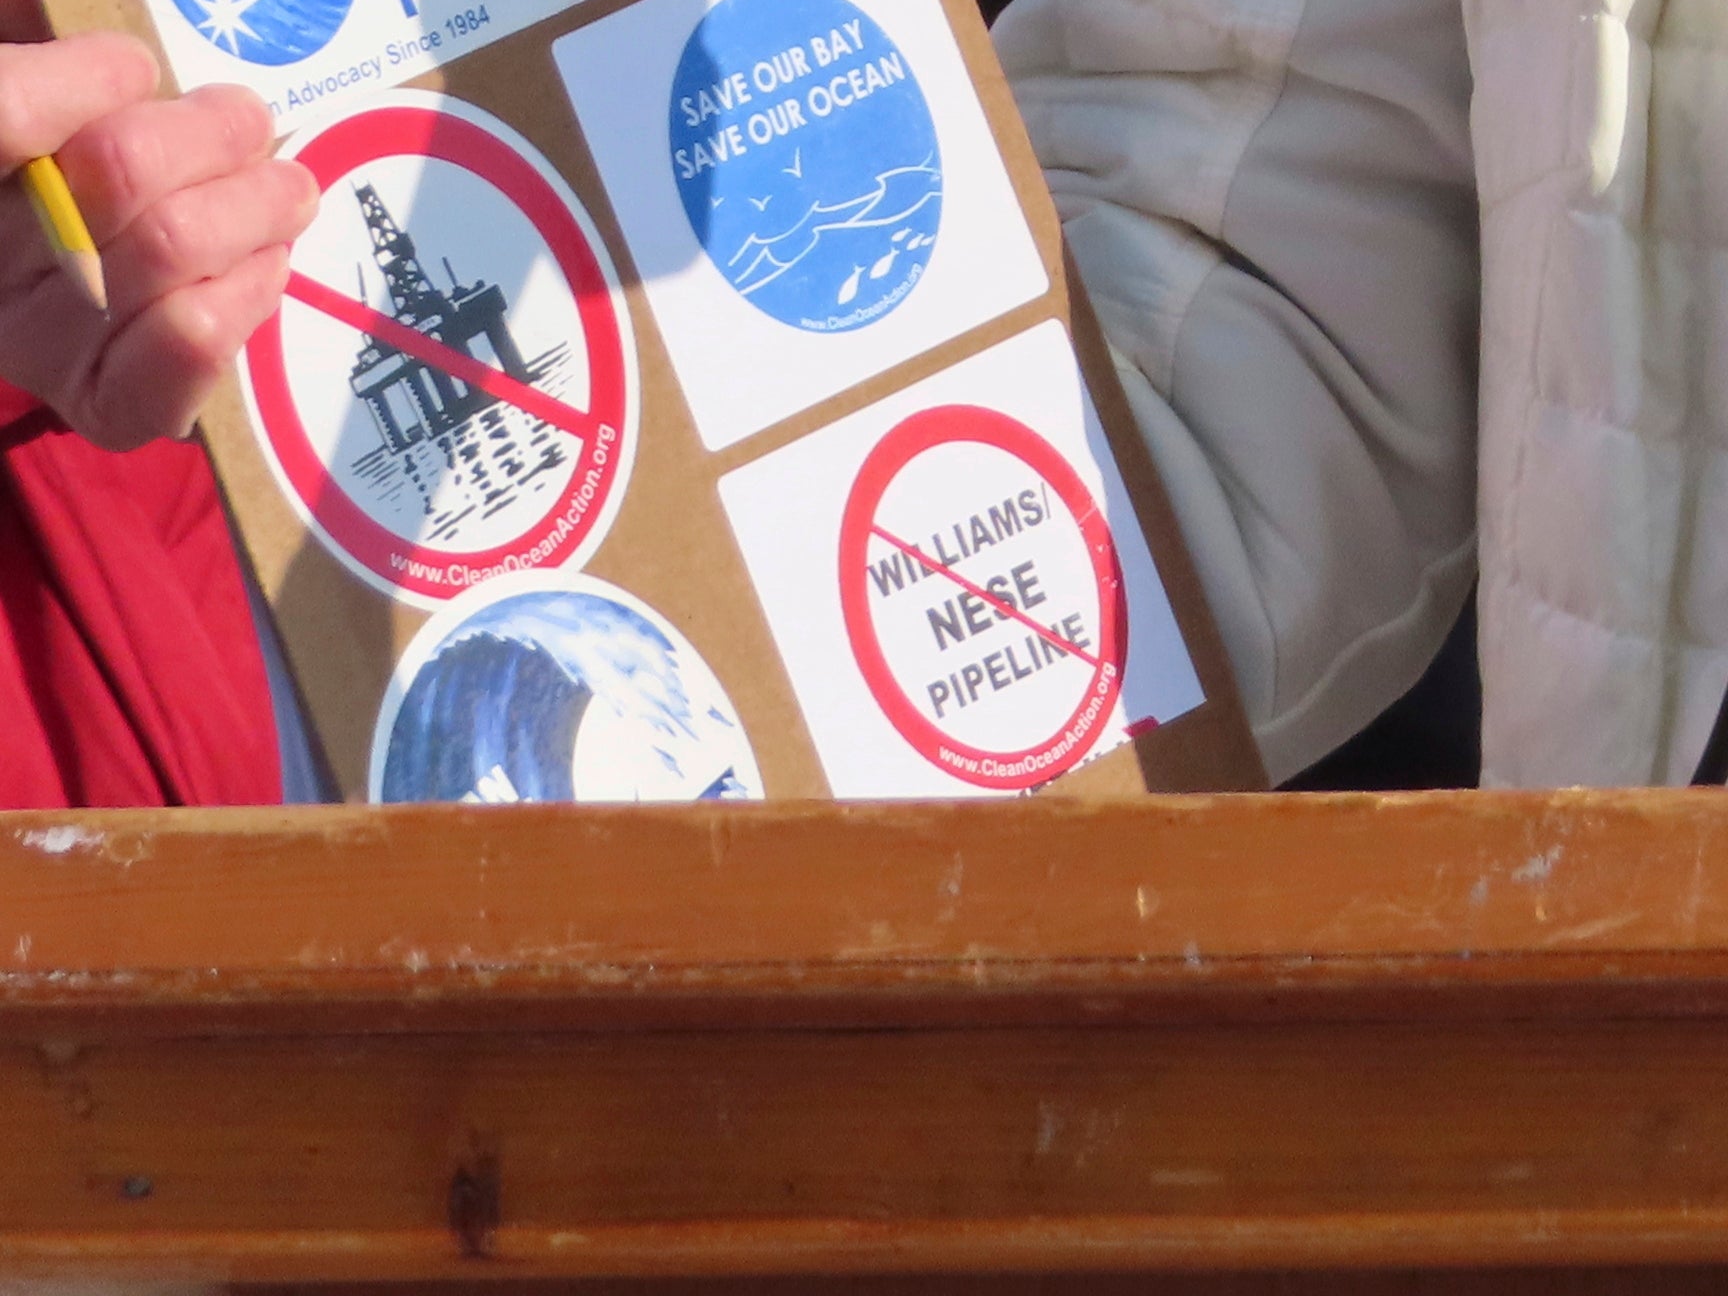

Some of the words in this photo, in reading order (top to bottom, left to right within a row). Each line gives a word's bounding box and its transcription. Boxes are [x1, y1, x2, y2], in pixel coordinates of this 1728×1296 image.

[287, 56, 383, 110] Advocacy
[386, 31, 442, 65] Since
[446, 4, 490, 39] 1984
[680, 72, 752, 127] SAVE
[753, 46, 811, 93] OUR
[810, 19, 866, 67] BAY
[675, 124, 747, 179] SAVE
[749, 99, 807, 145] OUR
[808, 52, 905, 117] OCEAN
[389, 423, 616, 586] www.CleanOceanAction.org
[926, 560, 1047, 652] NESE
[926, 611, 1092, 719] PIPELINE
[938, 661, 1117, 777] www.CleanOceanAction.org
